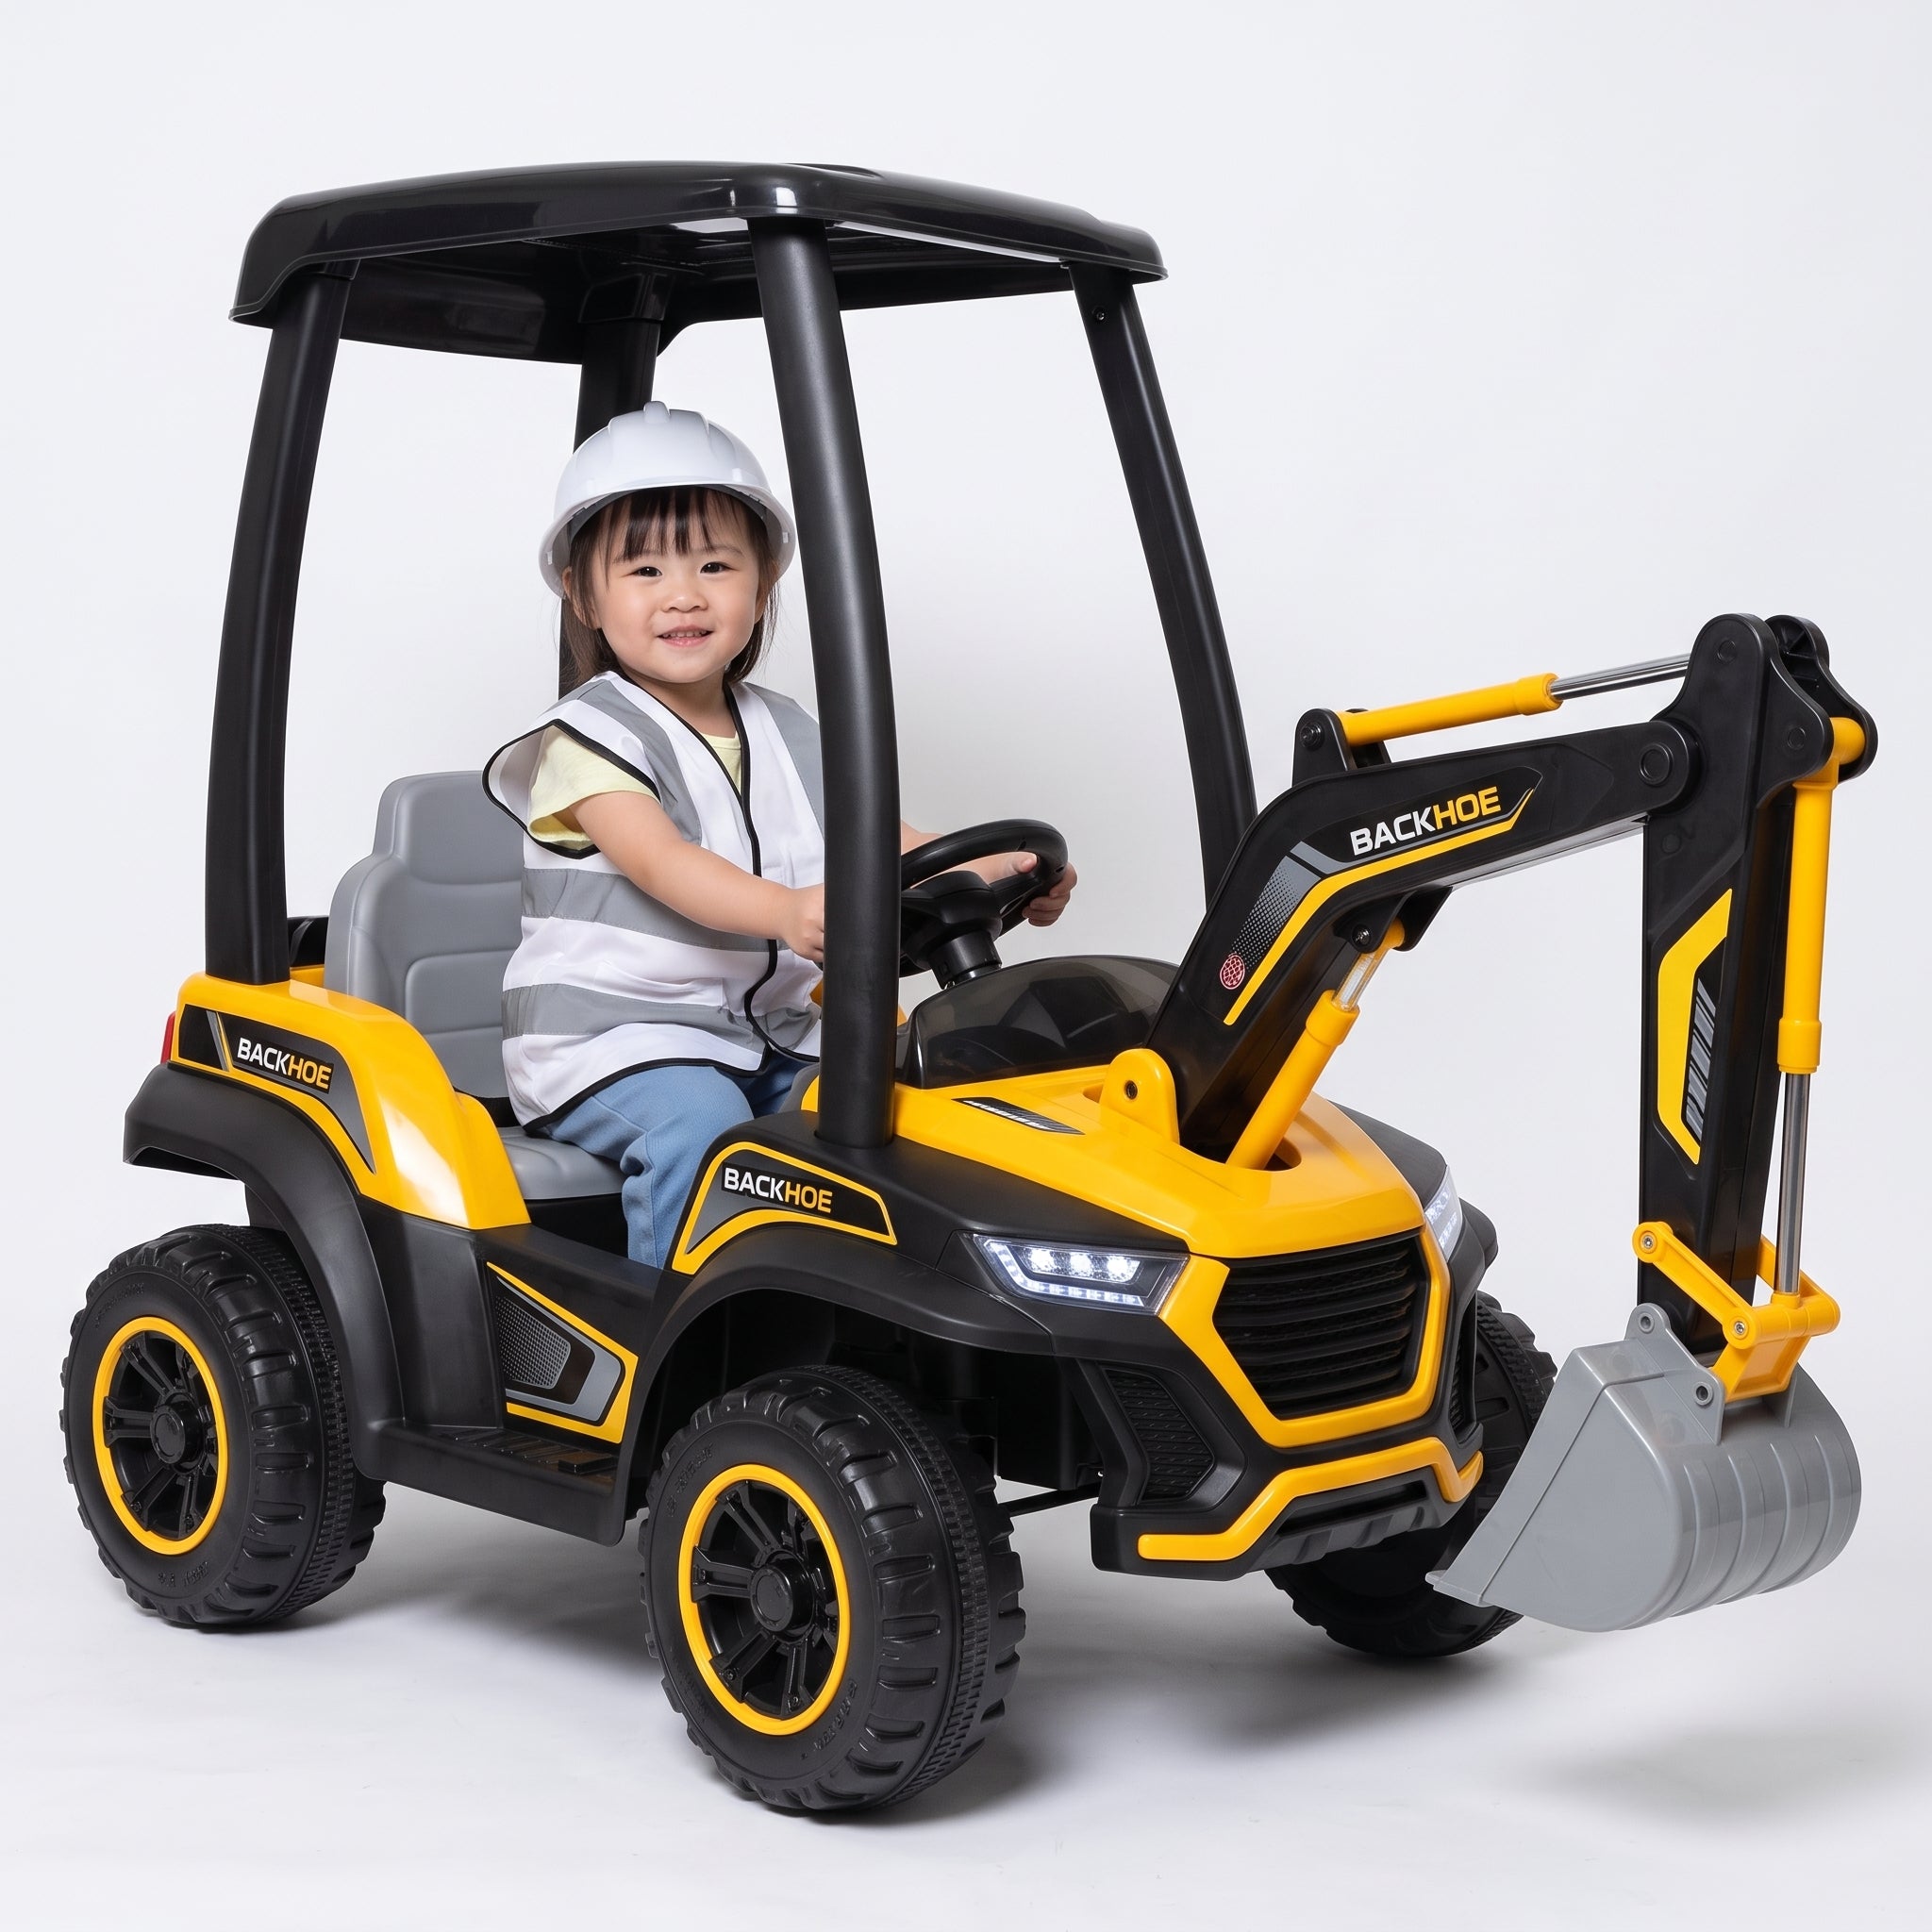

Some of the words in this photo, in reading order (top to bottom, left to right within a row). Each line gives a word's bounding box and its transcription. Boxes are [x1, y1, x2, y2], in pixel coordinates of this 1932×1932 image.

[1350, 786, 1502, 857] BACKHOE
[237, 1037, 332, 1090] BACKHOE
[724, 1167, 833, 1213] BACKHOE
